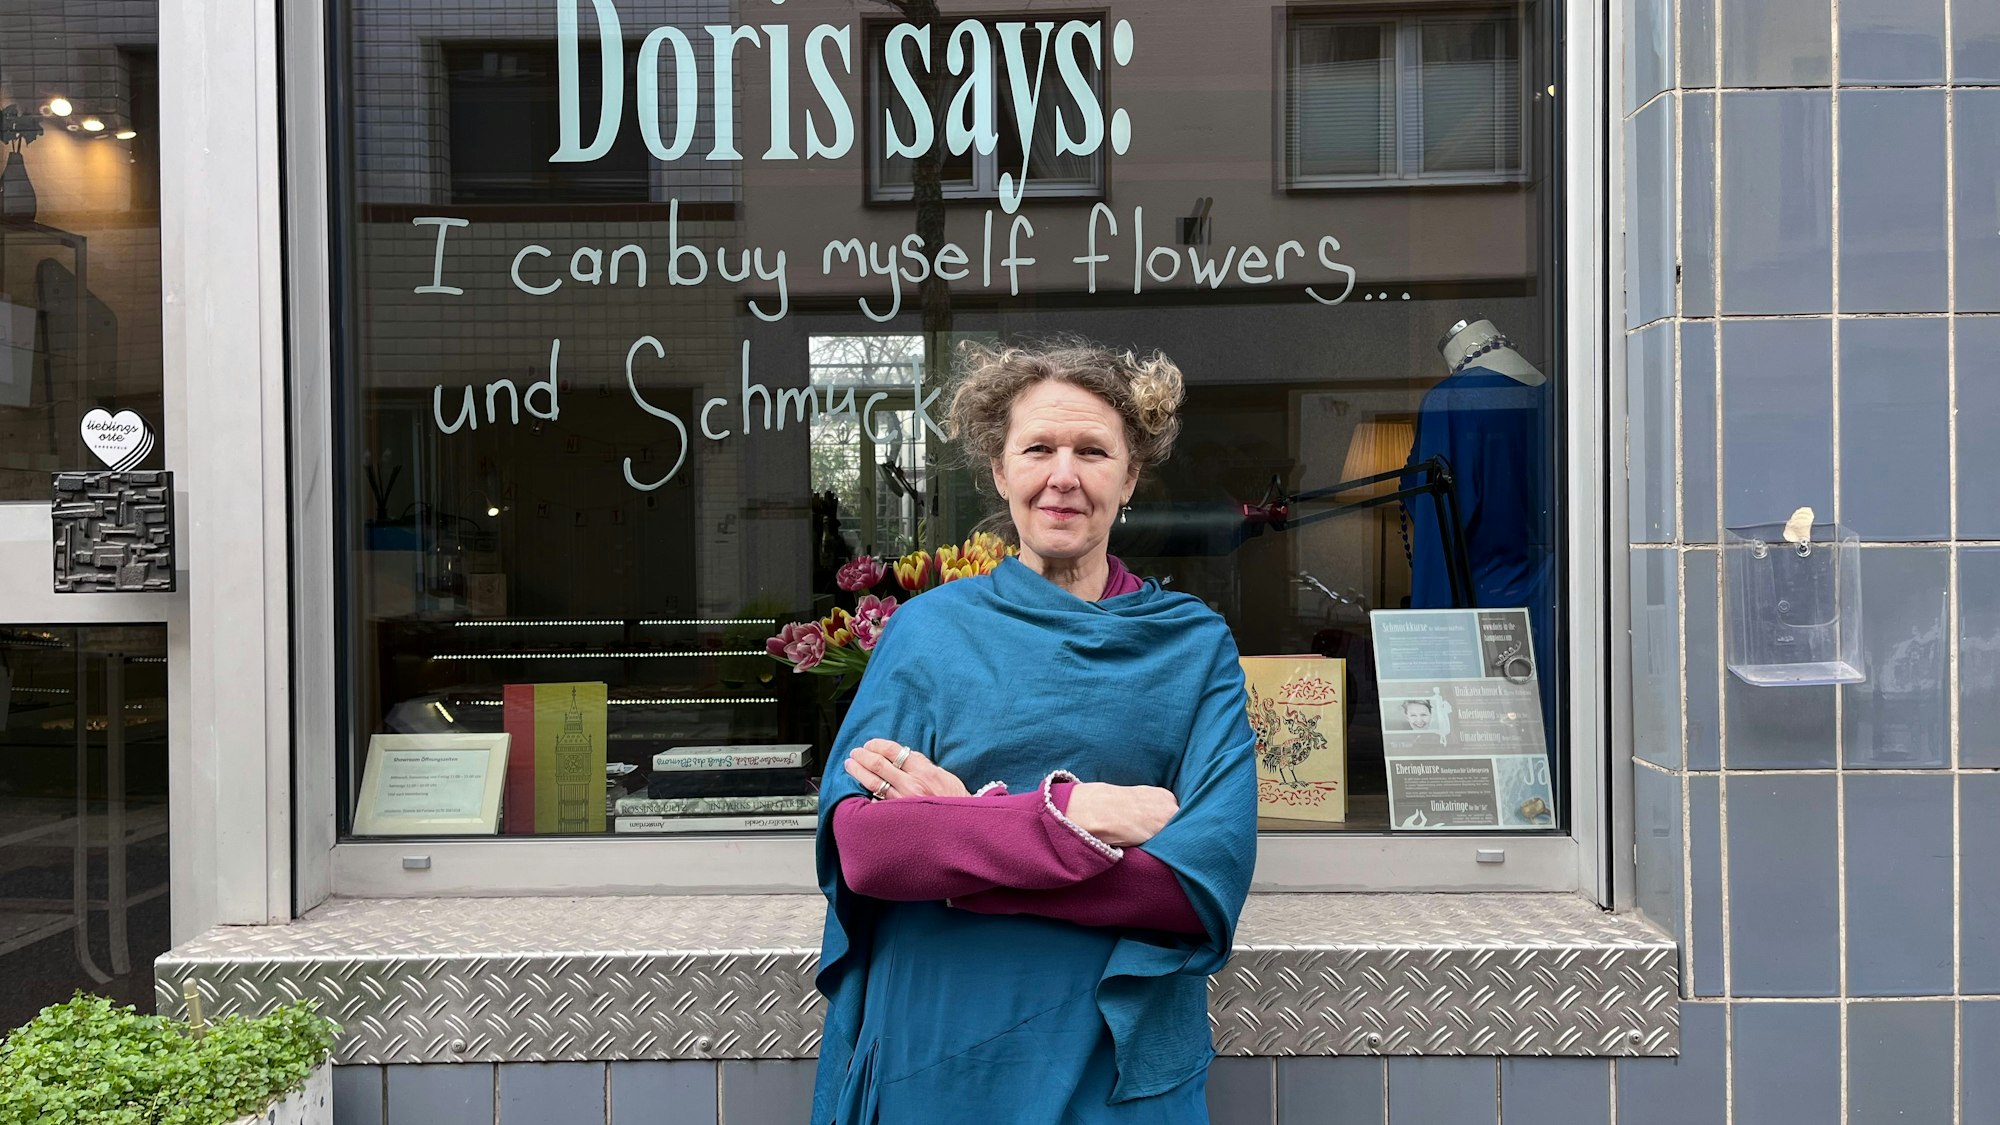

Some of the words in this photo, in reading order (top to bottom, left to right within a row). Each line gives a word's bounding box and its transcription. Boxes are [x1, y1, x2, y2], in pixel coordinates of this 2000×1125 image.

[549, 0, 855, 162] Doris
[884, 18, 1134, 215] says:
[414, 217, 470, 295] I
[510, 244, 647, 295] can
[668, 197, 788, 322] buy
[822, 210, 1036, 322] myself
[433, 338, 561, 434] und
[623, 335, 948, 490] Schmuck
[86, 420, 139, 435] lieblings
[98, 432, 125, 442] orte
[1395, 763, 1440, 776] Eheringkurse
[1430, 799, 1469, 813] Unikatringe
[629, 821, 665, 829] Amsterdam
